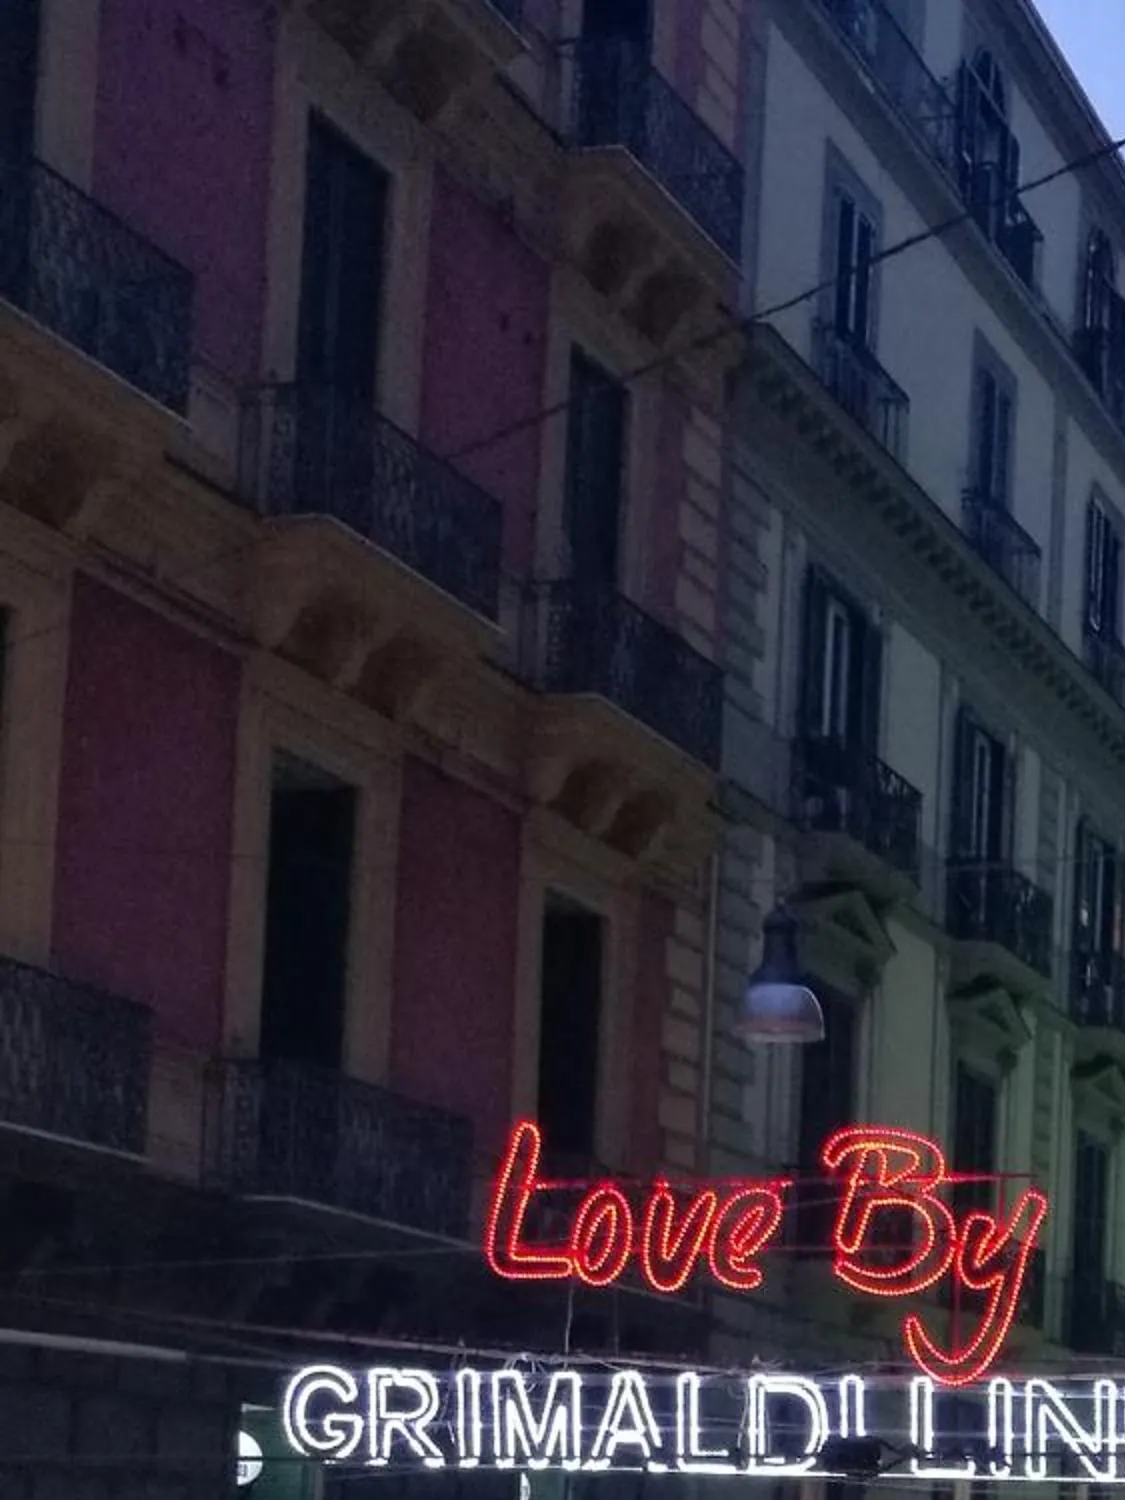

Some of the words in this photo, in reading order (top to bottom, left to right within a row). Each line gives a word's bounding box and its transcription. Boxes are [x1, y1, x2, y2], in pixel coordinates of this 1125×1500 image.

[484, 1119, 784, 1292] Love
[822, 1125, 1049, 1386] By
[283, 1365, 866, 1477] GRIMALDI
